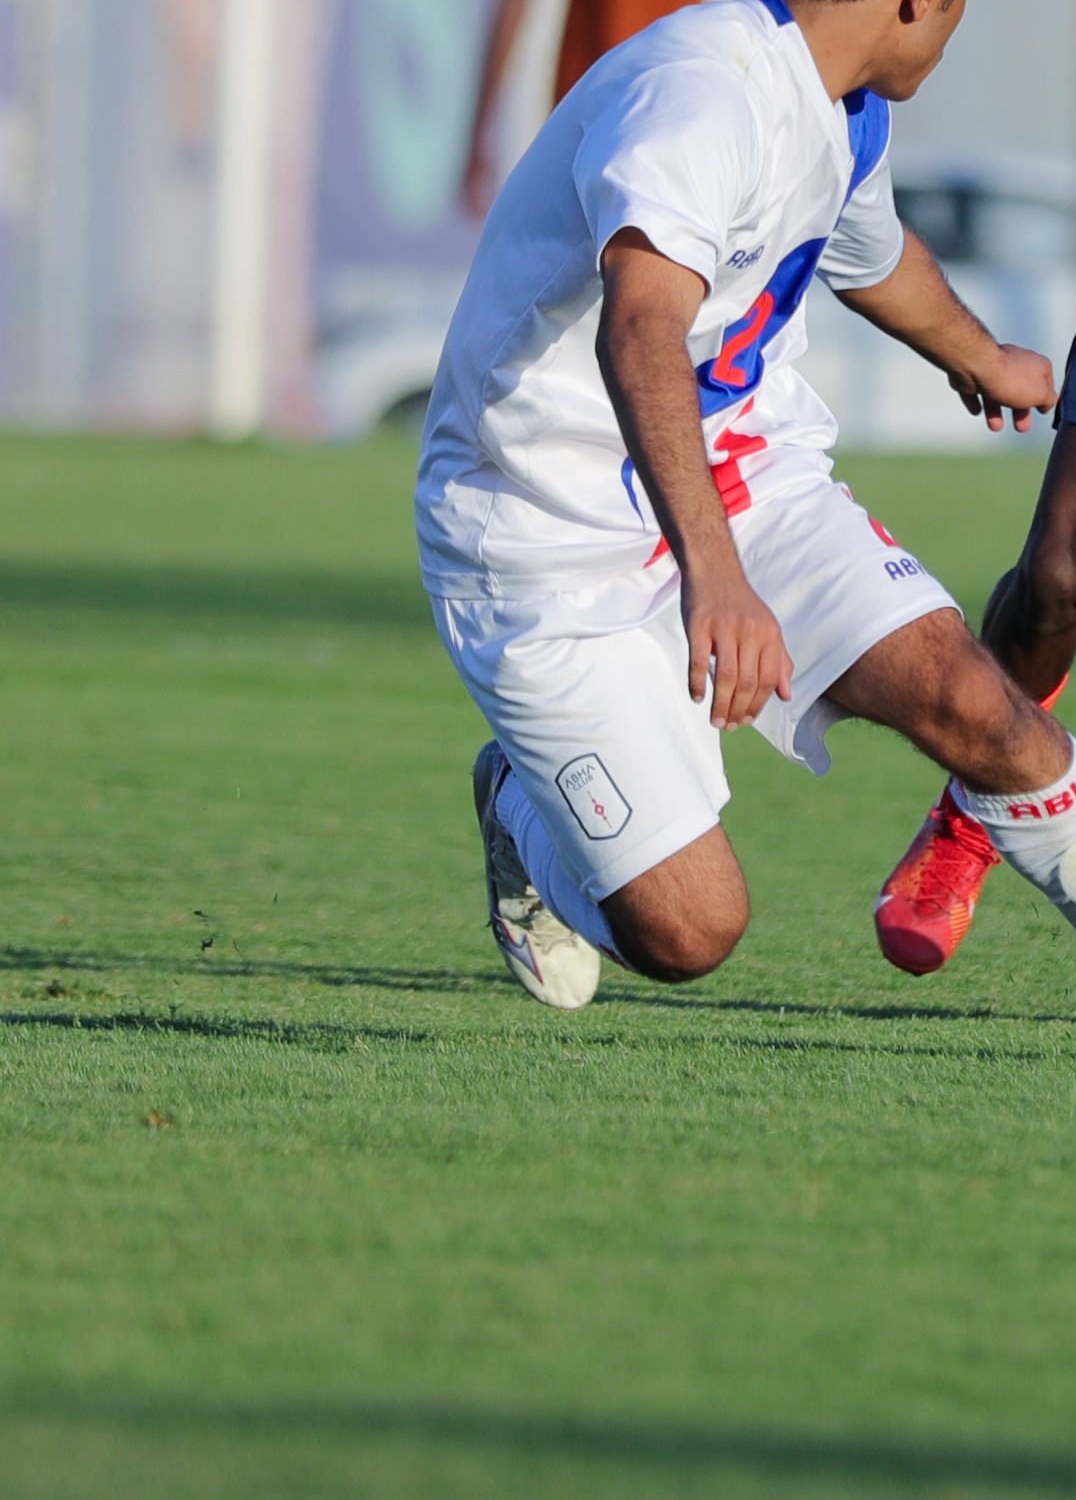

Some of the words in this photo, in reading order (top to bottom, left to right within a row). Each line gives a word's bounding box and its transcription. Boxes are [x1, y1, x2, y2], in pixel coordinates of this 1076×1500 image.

[711, 290, 774, 387] 2
[565, 763, 596, 788] ABHA
[573, 774, 594, 791] CLUB
